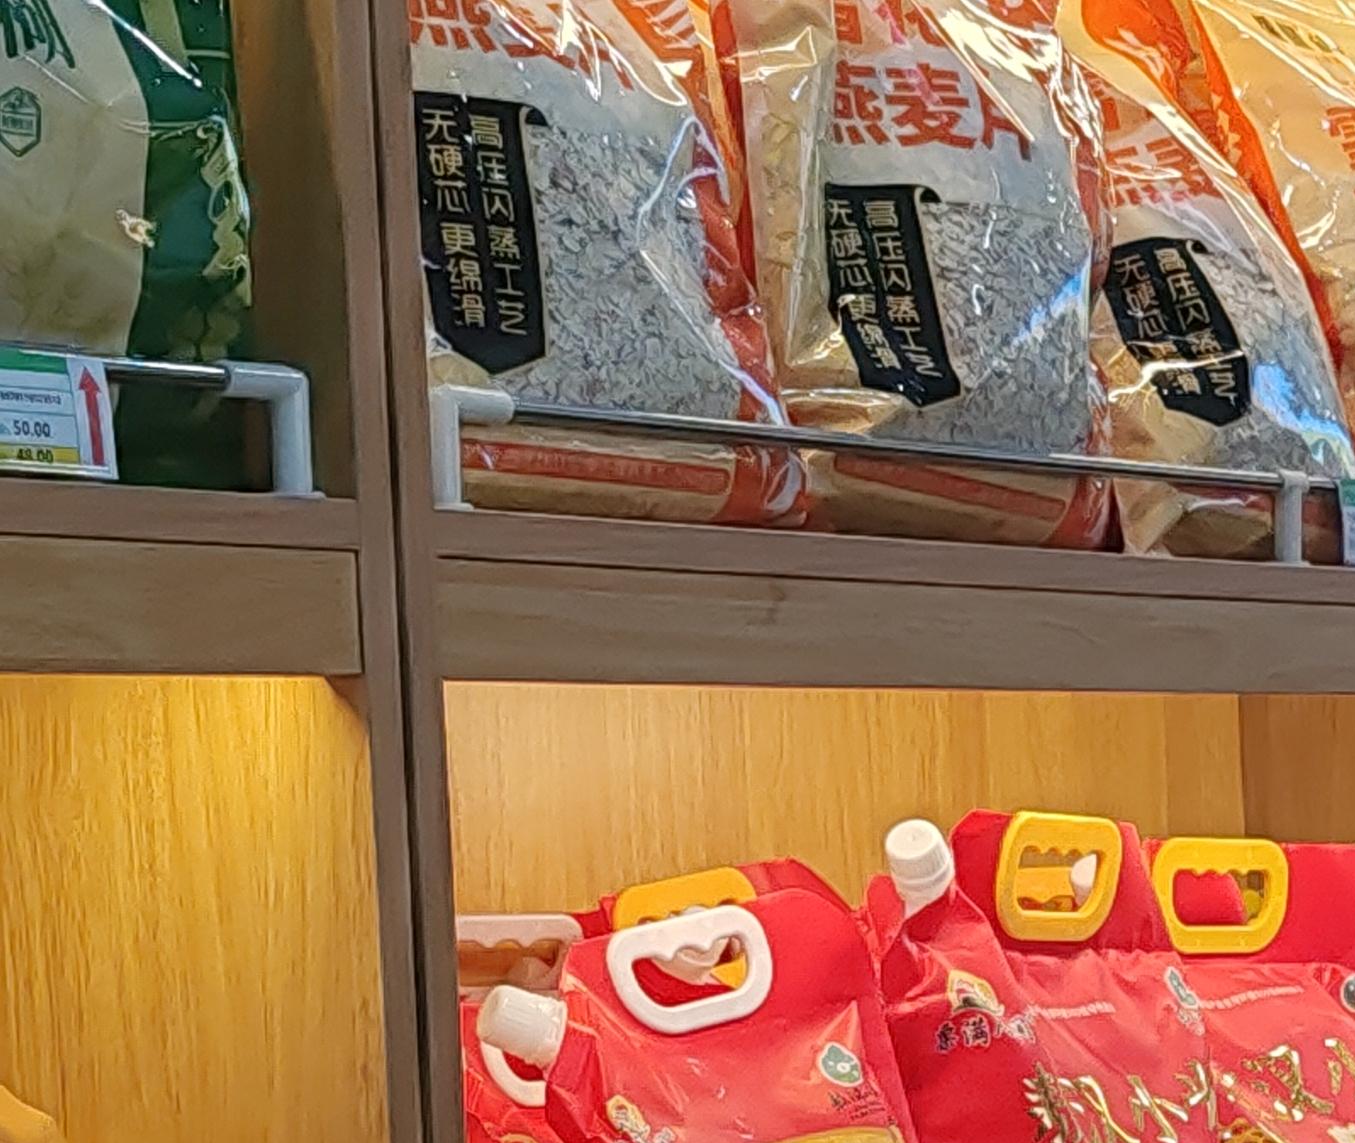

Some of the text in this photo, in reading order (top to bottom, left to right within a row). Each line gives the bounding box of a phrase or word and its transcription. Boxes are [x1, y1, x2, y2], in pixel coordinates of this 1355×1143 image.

[469, 113, 532, 337] 高压闪蒸工艺
[13, 419, 51, 438] 50.00
